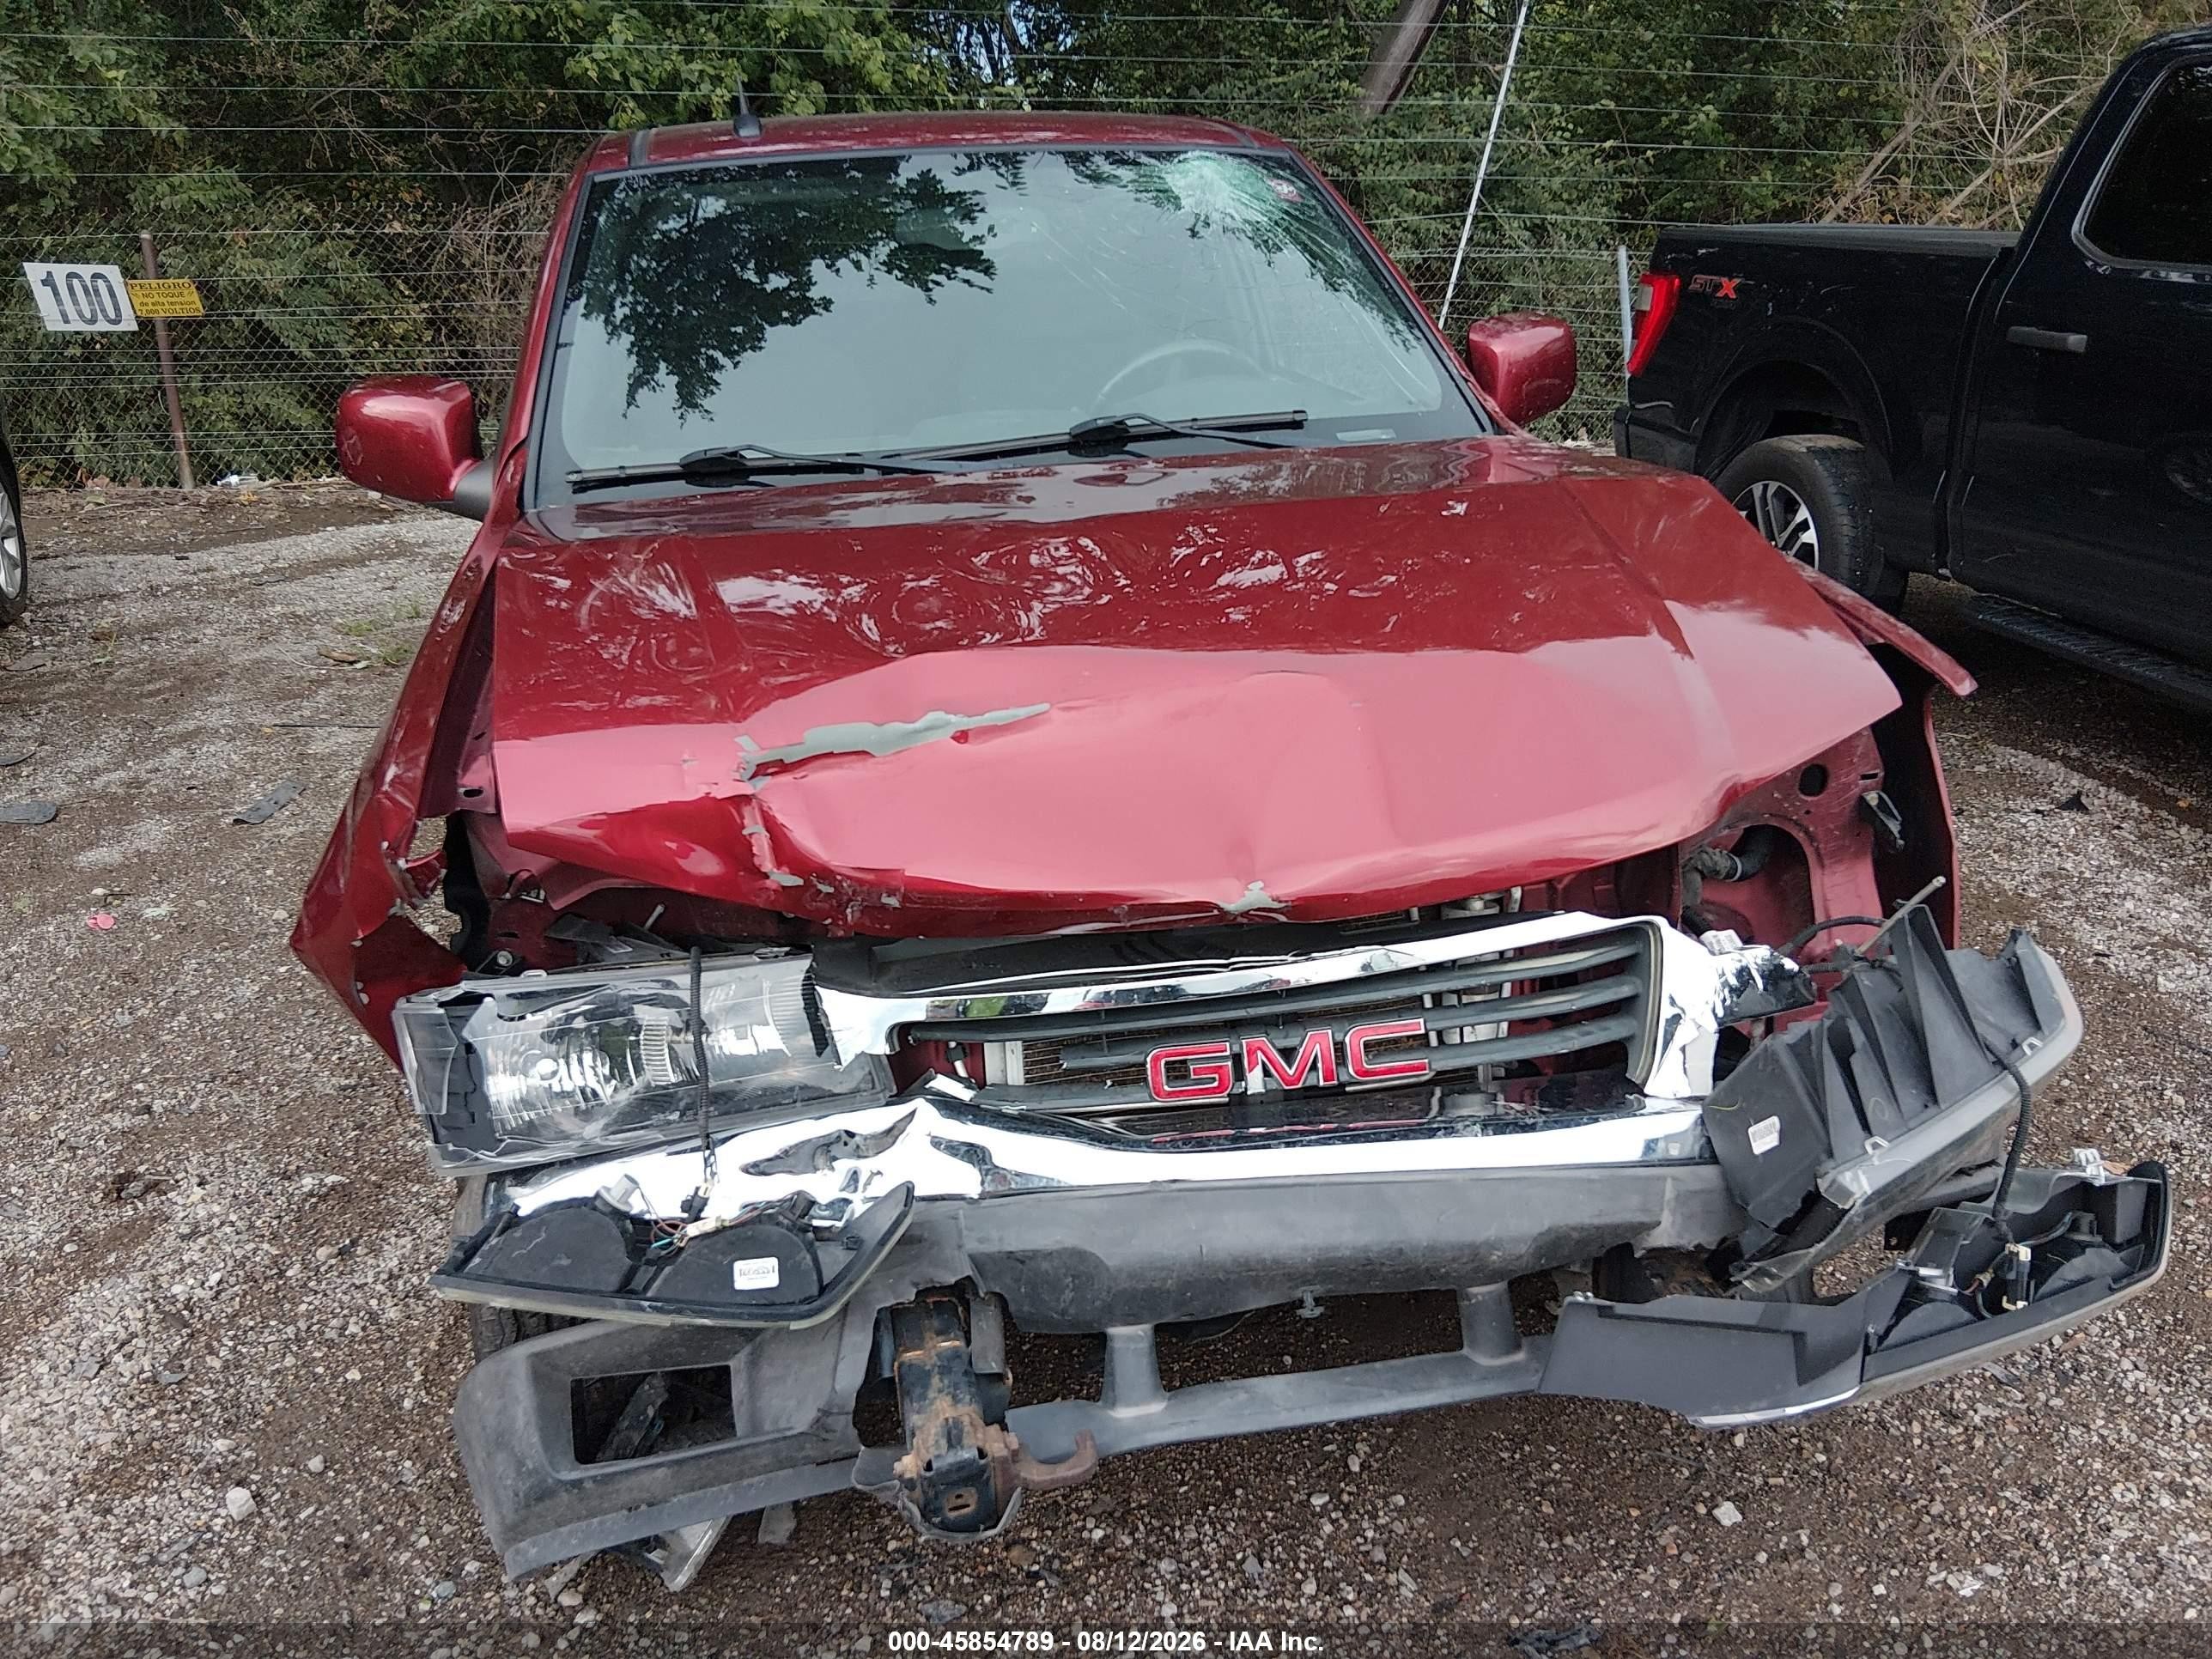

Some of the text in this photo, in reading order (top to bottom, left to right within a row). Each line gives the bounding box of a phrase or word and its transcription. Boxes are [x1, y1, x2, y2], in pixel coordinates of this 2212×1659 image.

[40, 270, 122, 325] 100
[130, 282, 191, 290] PELIGRO
[1688, 274, 1745, 299] STX
[161, 307, 201, 315] VOLTIOS
[1146, 1018, 1430, 1103] GMC
